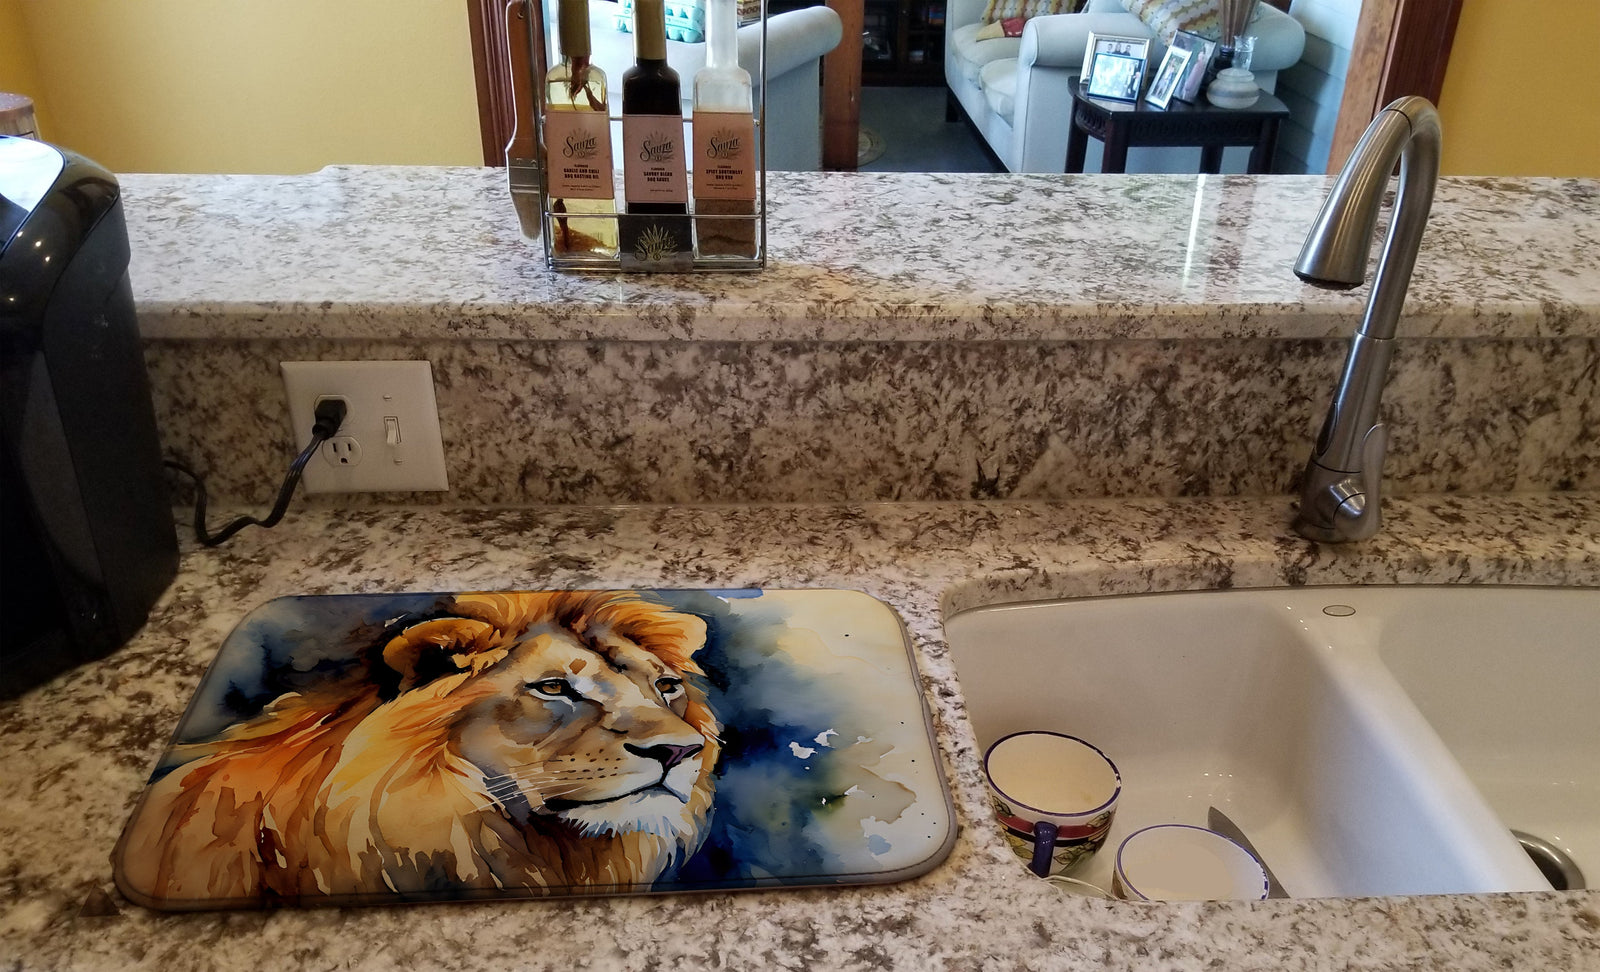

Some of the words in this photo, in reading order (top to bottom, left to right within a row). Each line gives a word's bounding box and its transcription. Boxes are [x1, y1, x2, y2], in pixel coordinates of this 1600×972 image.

[563, 136, 597, 158] Sauza
[640, 140, 674, 161] Sauza
[707, 137, 740, 159] Sauza
